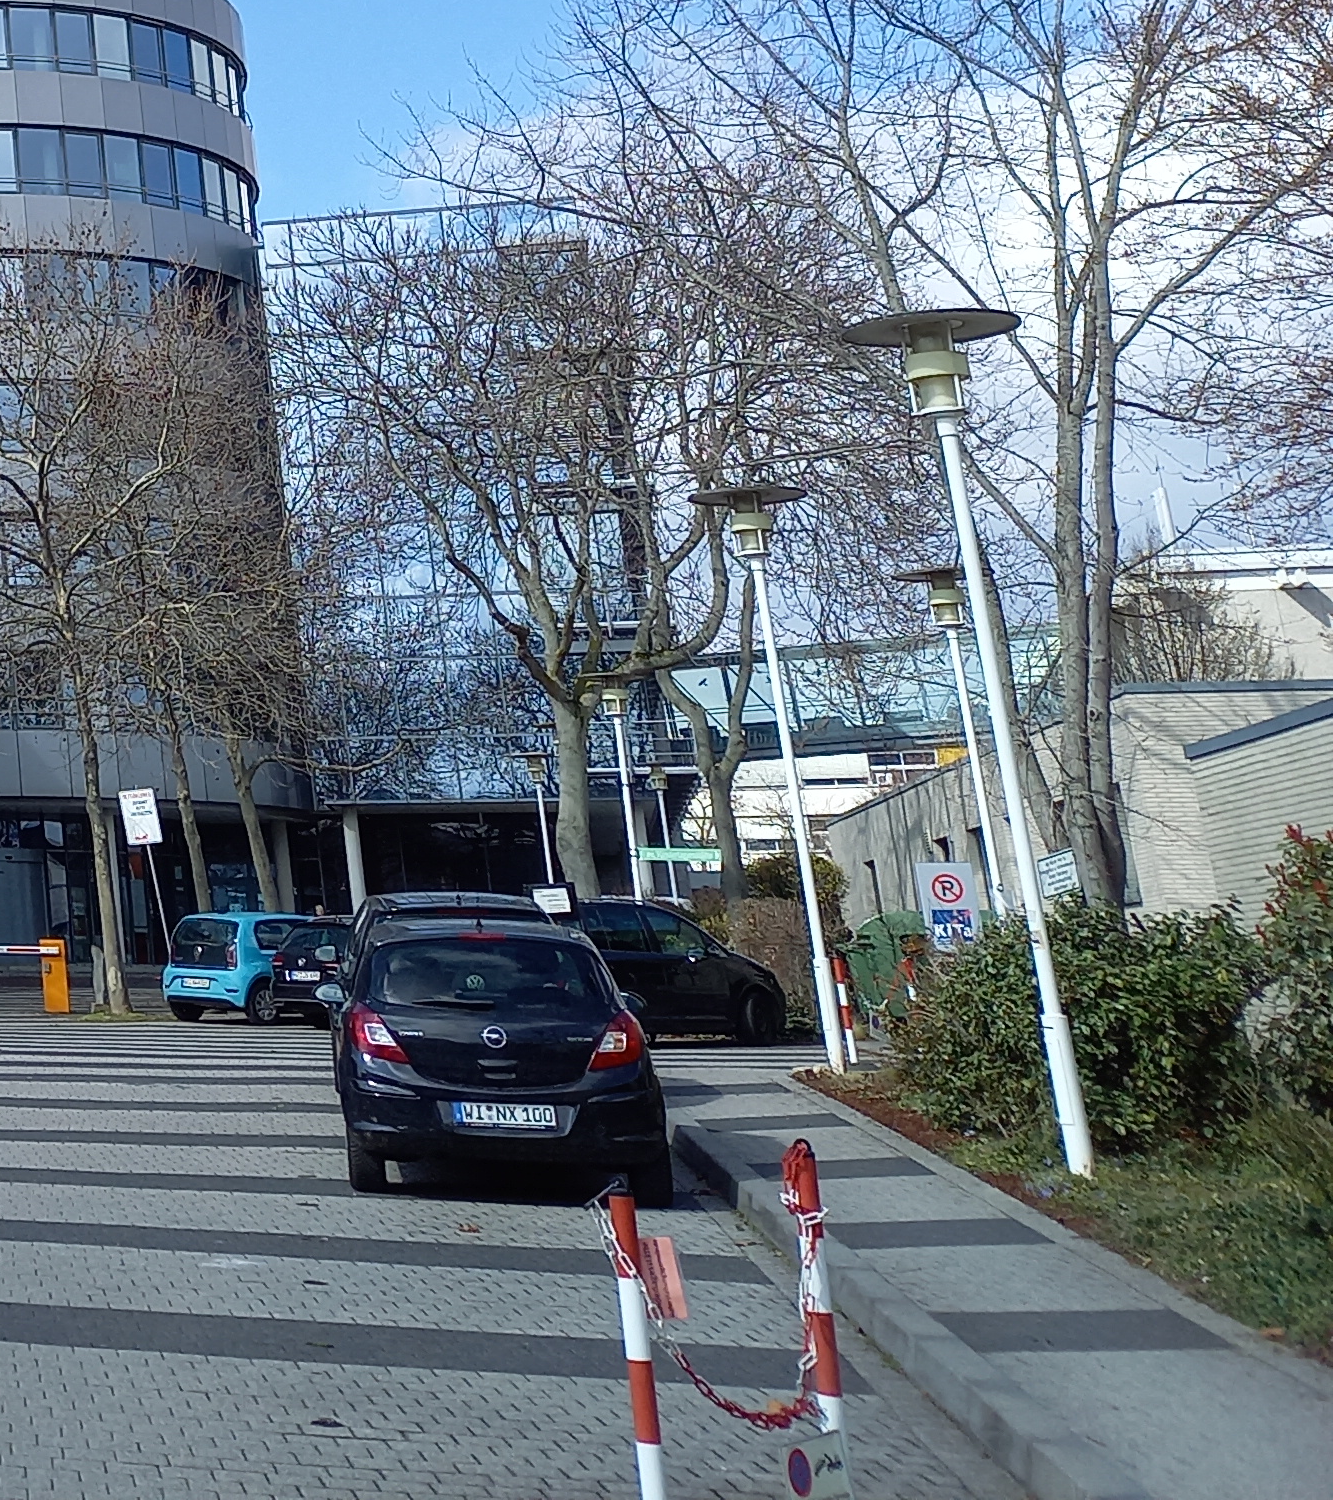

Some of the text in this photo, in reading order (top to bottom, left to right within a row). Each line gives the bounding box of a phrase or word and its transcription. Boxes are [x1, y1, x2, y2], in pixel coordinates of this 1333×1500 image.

[462, 1104, 554, 1123] WI NX 100
